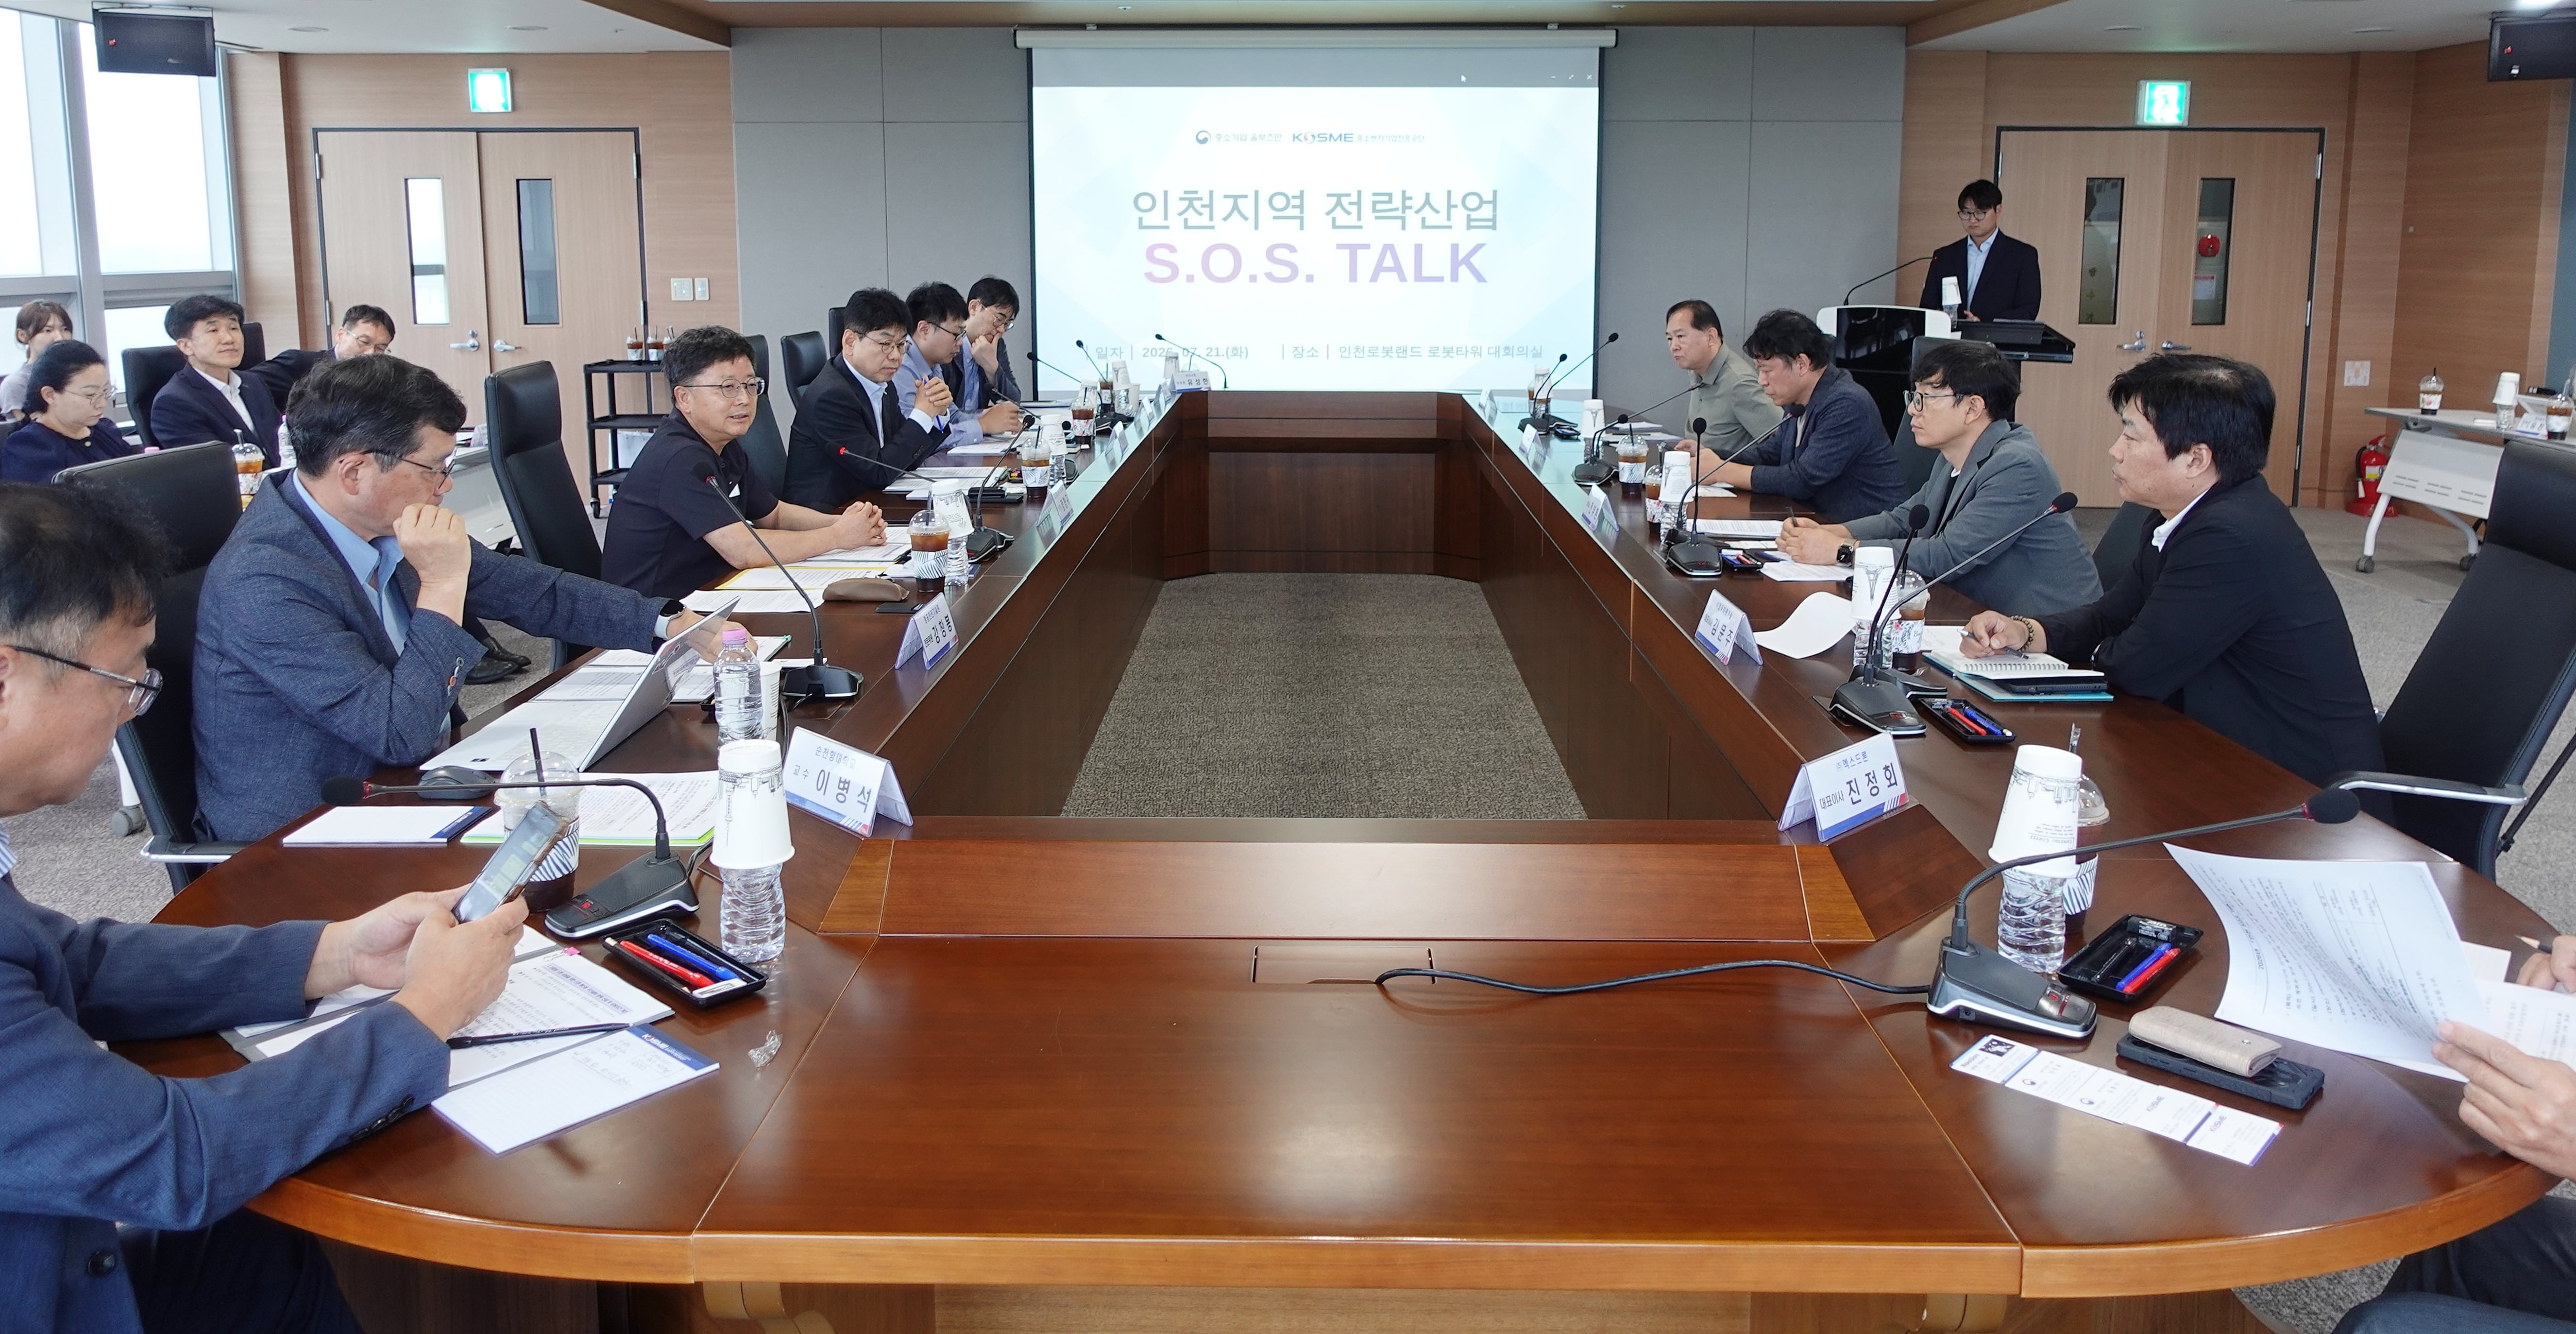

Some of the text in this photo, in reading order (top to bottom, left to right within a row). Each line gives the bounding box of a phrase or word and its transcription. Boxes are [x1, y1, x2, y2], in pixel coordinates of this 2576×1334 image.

[1215, 133, 1247, 142] 중소기업
[1293, 131, 1353, 144] KOSME
[1133, 189, 1499, 231] 인천지역 전략산업
[1144, 242, 1488, 284] S.O.S. TALK
[1095, 346, 1124, 359] 일자
[1206, 346, 1248, 359] 21.(화)
[1291, 345, 1319, 359] 장소
[1338, 345, 1543, 359] 인천로봇랜드 로봇타워 대회의실
[932, 614, 952, 643] 강창봉
[1711, 619, 1733, 647] 김문주
[816, 746, 856, 768] 순천향대학교
[793, 764, 872, 813] 교수 이병석
[1819, 762, 1898, 809] 대표이사 진정회
[641, 1033, 670, 1052] KOSME
